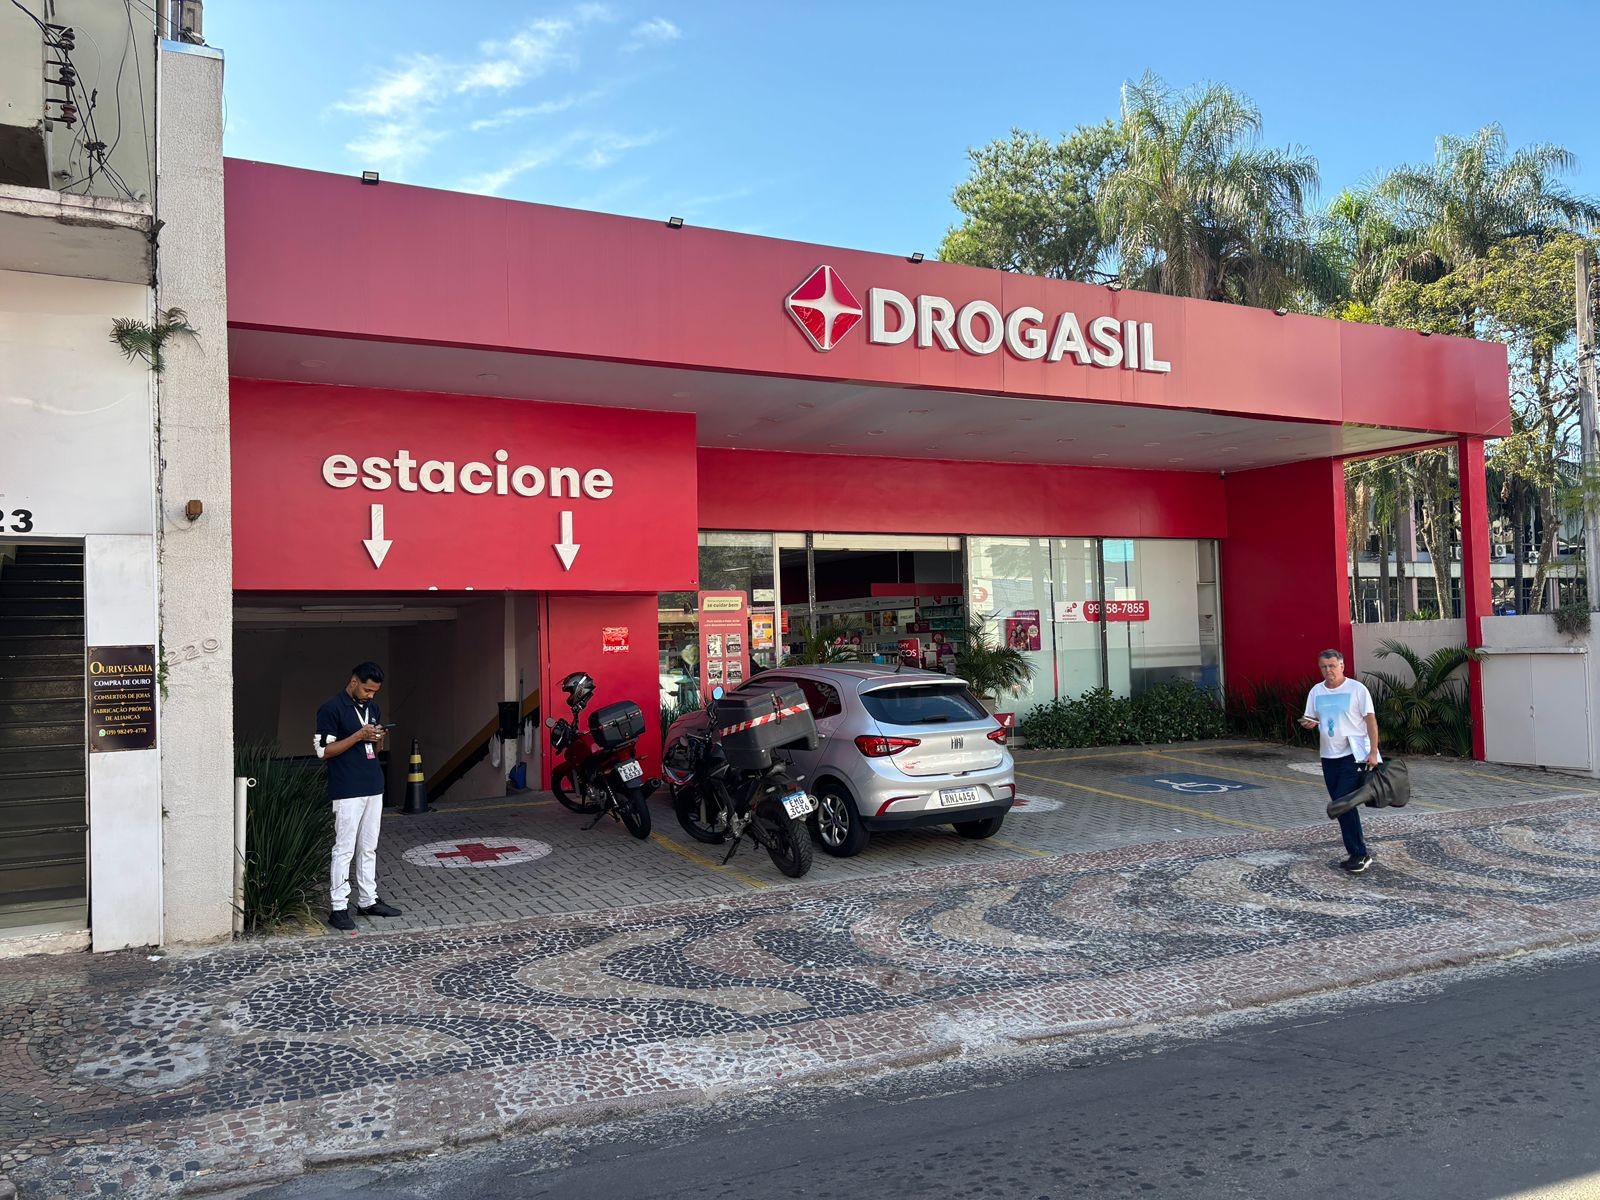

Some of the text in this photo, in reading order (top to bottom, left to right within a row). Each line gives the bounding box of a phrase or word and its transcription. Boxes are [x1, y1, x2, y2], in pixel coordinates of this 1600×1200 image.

[869, 287, 1172, 374] DROGASIL
[322, 449, 614, 499] estacione
[0, 509, 33, 532] 3
[1087, 602, 1145, 614] 9958-7855
[166, 638, 220, 667] 220
[93, 706, 128, 714] FABRICAÇÃO
[789, 796, 805, 808] EMG
[790, 803, 810, 816] 3C36
